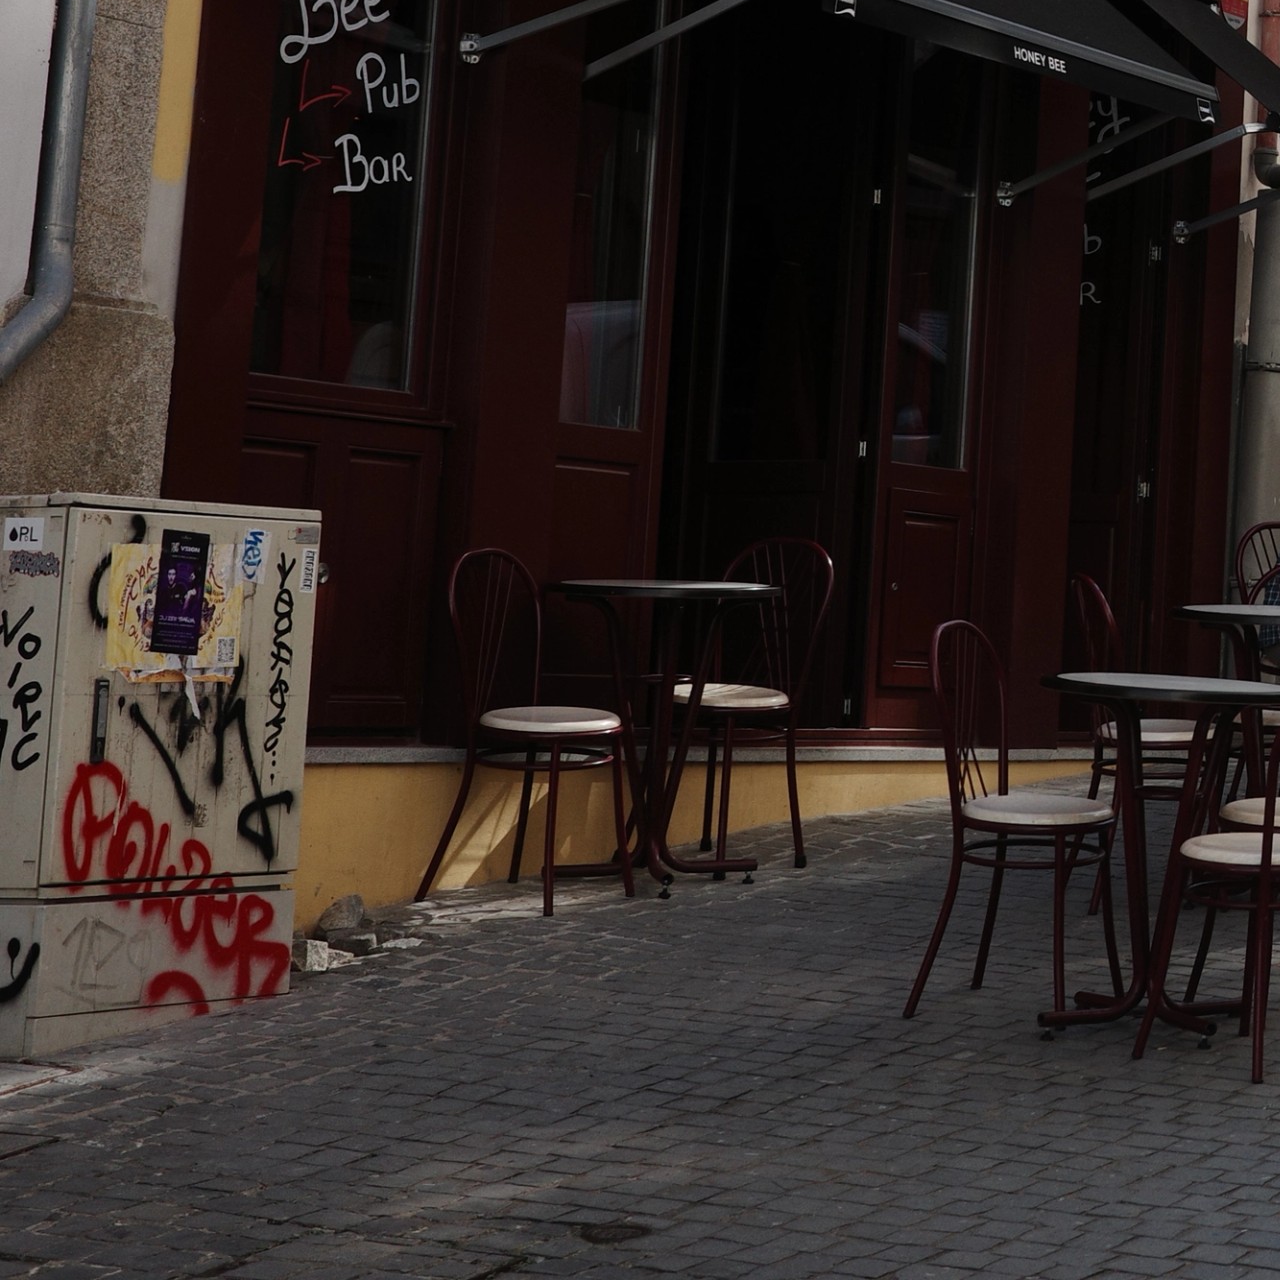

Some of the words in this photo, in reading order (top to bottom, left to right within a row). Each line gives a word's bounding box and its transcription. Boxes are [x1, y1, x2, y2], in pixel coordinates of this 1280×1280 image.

[1014, 45, 1046, 67] HONEY
[1048, 56, 1067, 74] BEE
[356, 52, 421, 114] Pub
